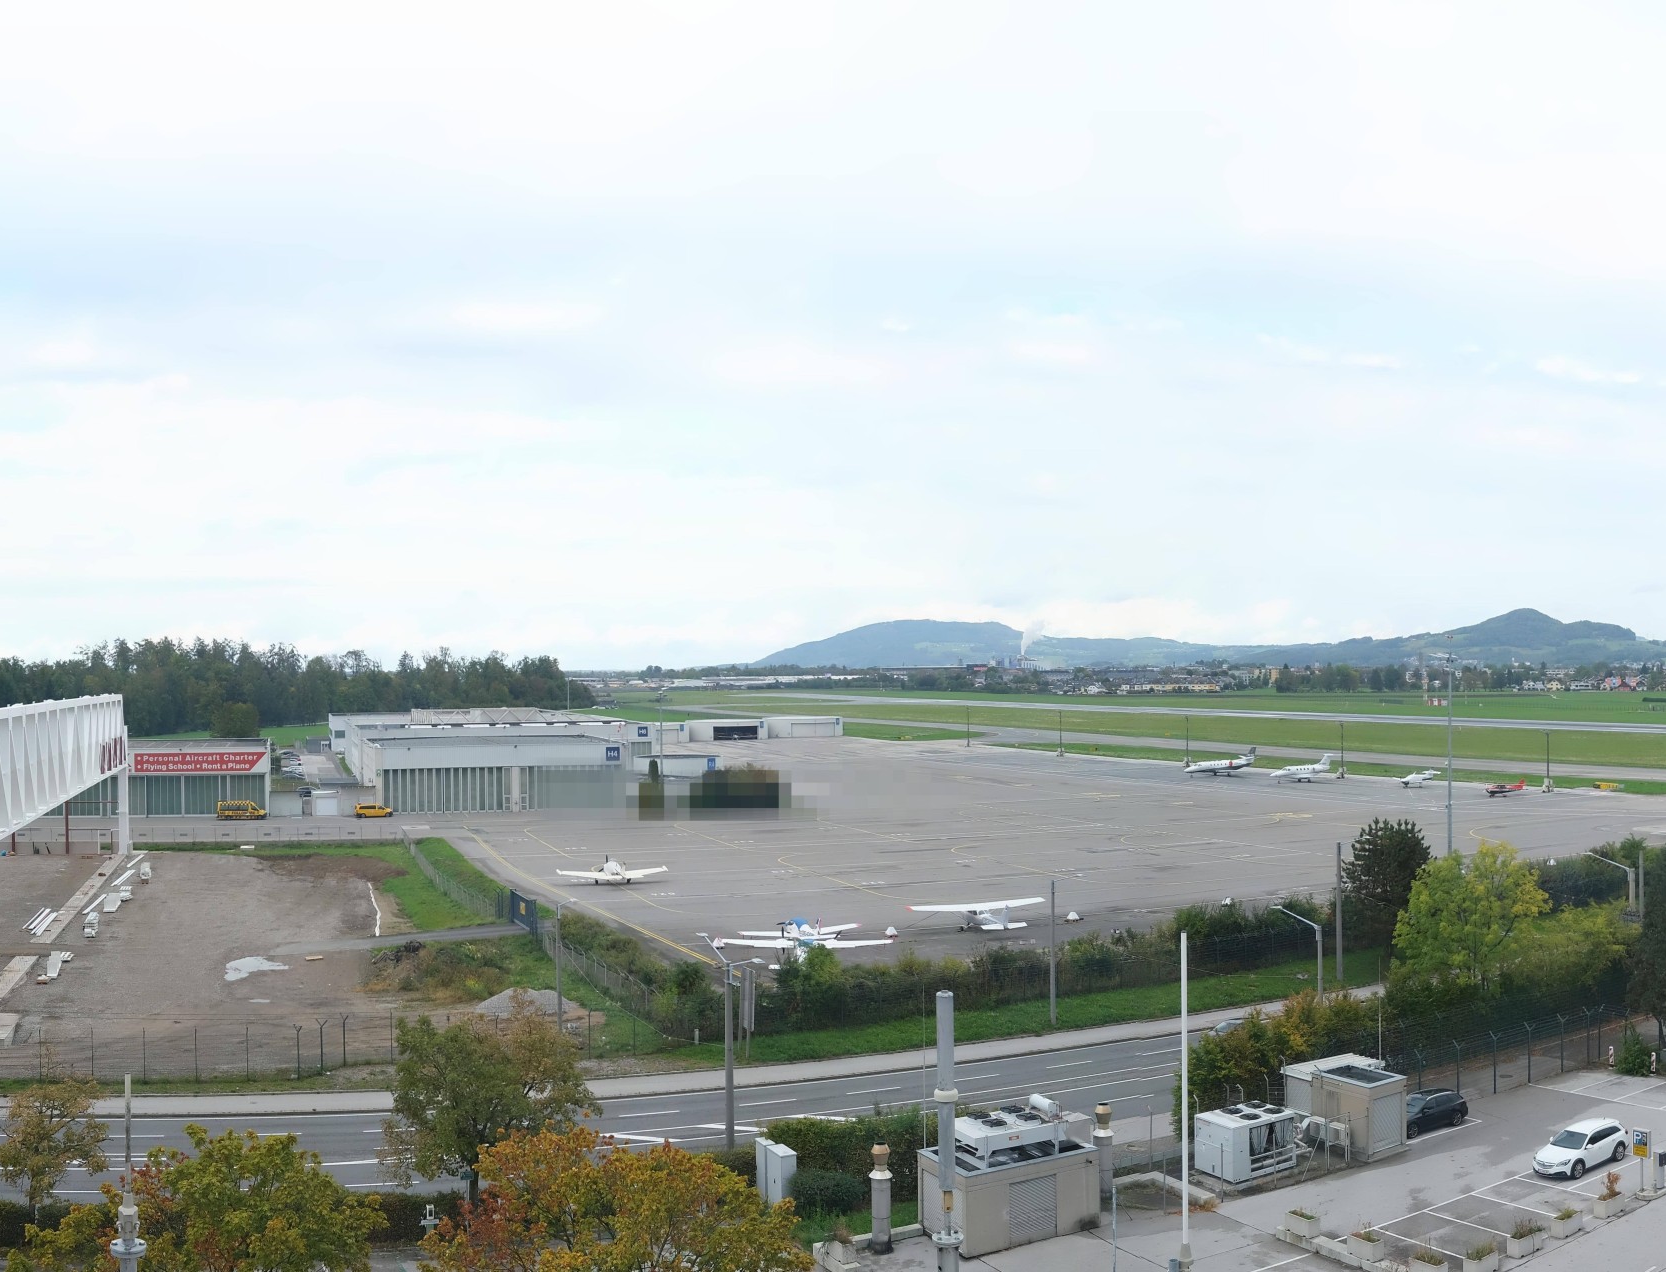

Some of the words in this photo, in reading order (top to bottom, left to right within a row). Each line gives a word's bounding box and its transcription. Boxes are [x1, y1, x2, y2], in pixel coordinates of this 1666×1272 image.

[607, 750, 618, 758] H4
[143, 763, 167, 771] Flying
[1633, 1131, 1642, 1144] P
